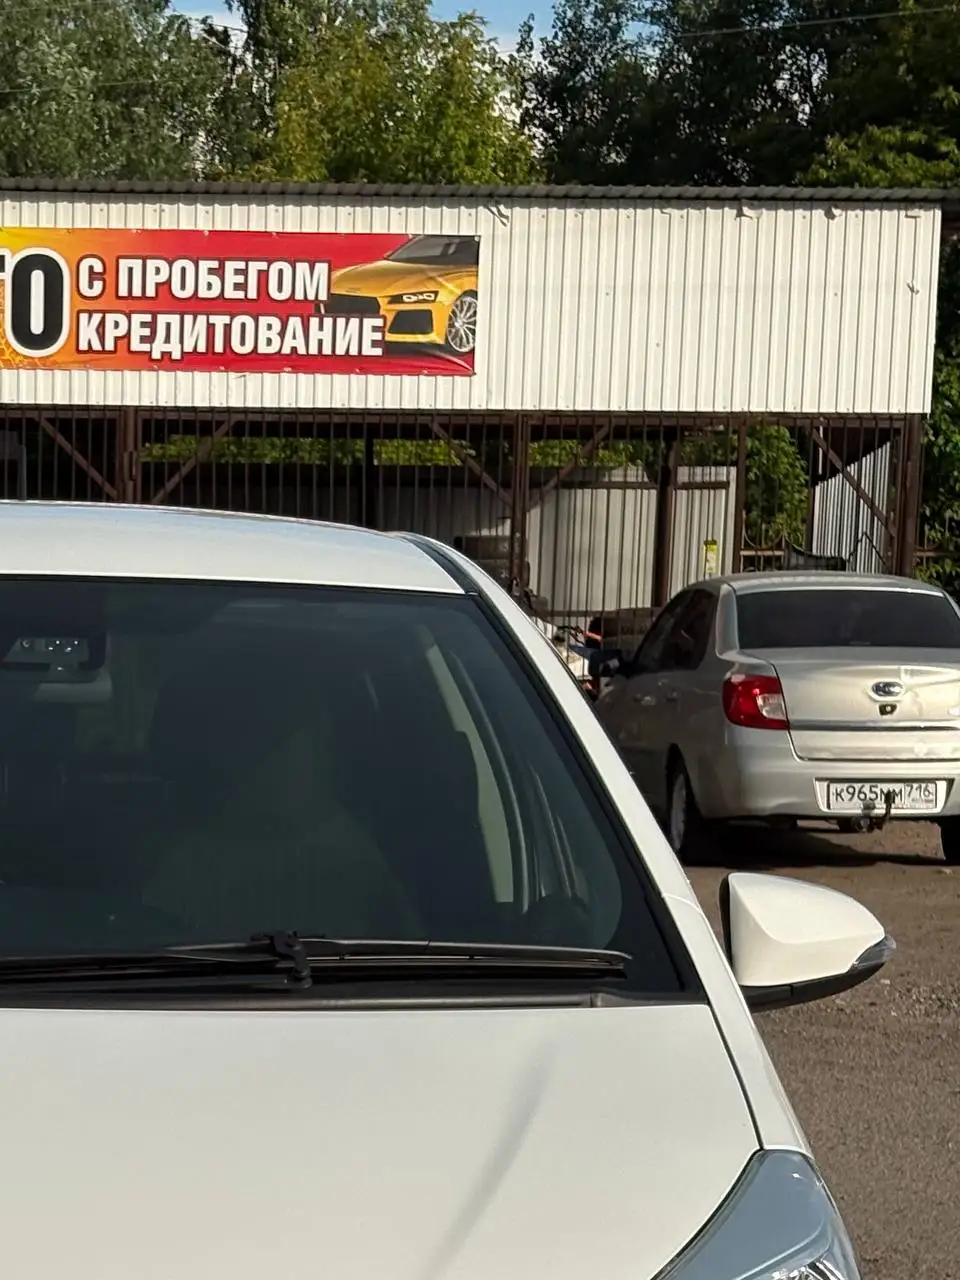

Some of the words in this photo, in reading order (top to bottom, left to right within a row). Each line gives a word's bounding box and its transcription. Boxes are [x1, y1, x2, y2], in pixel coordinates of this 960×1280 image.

[78, 257, 104, 298] С
[117, 257, 330, 302] ПРОБЕГОМ
[78, 312, 385, 361] КРЕДИТОВАНИЕ
